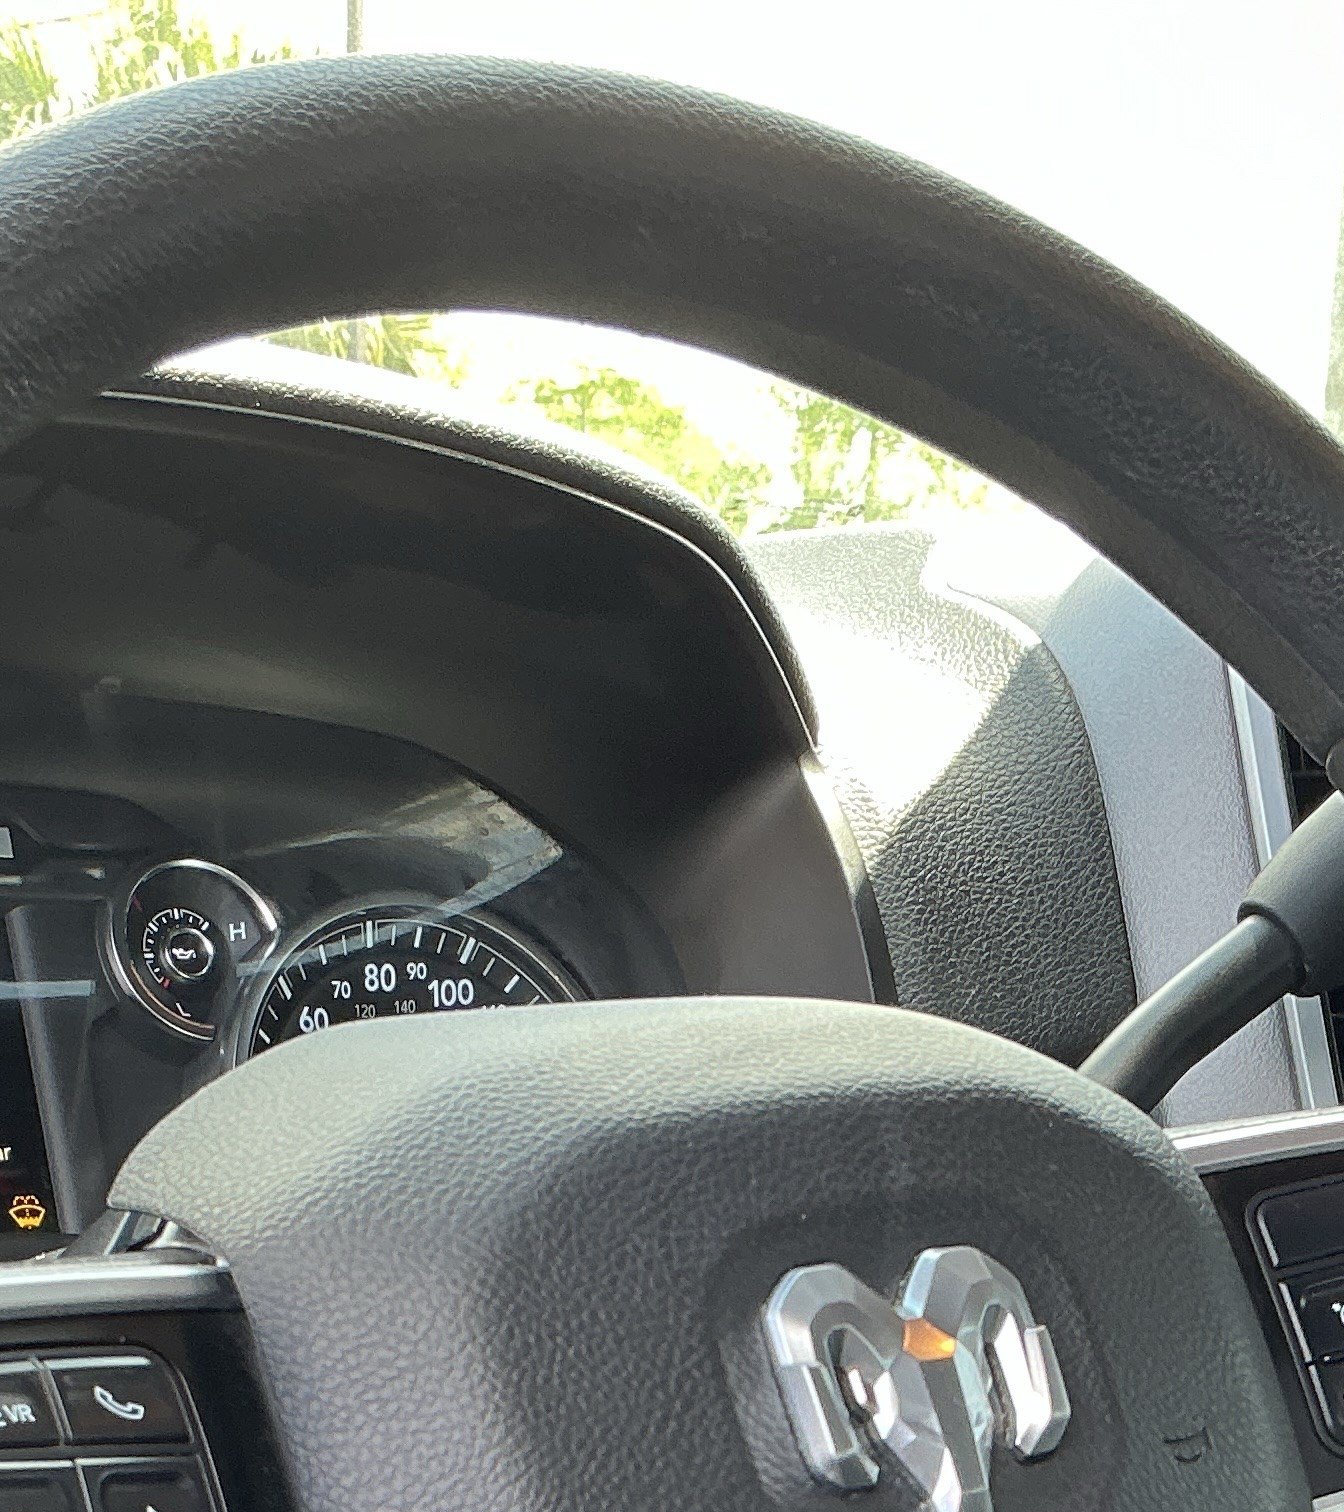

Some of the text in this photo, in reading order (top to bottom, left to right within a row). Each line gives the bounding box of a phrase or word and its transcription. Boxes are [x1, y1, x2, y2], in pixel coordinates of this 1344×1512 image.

[229, 921, 246, 941] H
[364, 963, 396, 992] 80
[406, 962, 427, 980] 90
[331, 980, 351, 999] 70
[427, 978, 474, 1008] 100
[355, 1004, 376, 1019] 120
[394, 999, 416, 1014] 140
[299, 1006, 329, 1033] 60
[7, 1404, 35, 1423] VR
